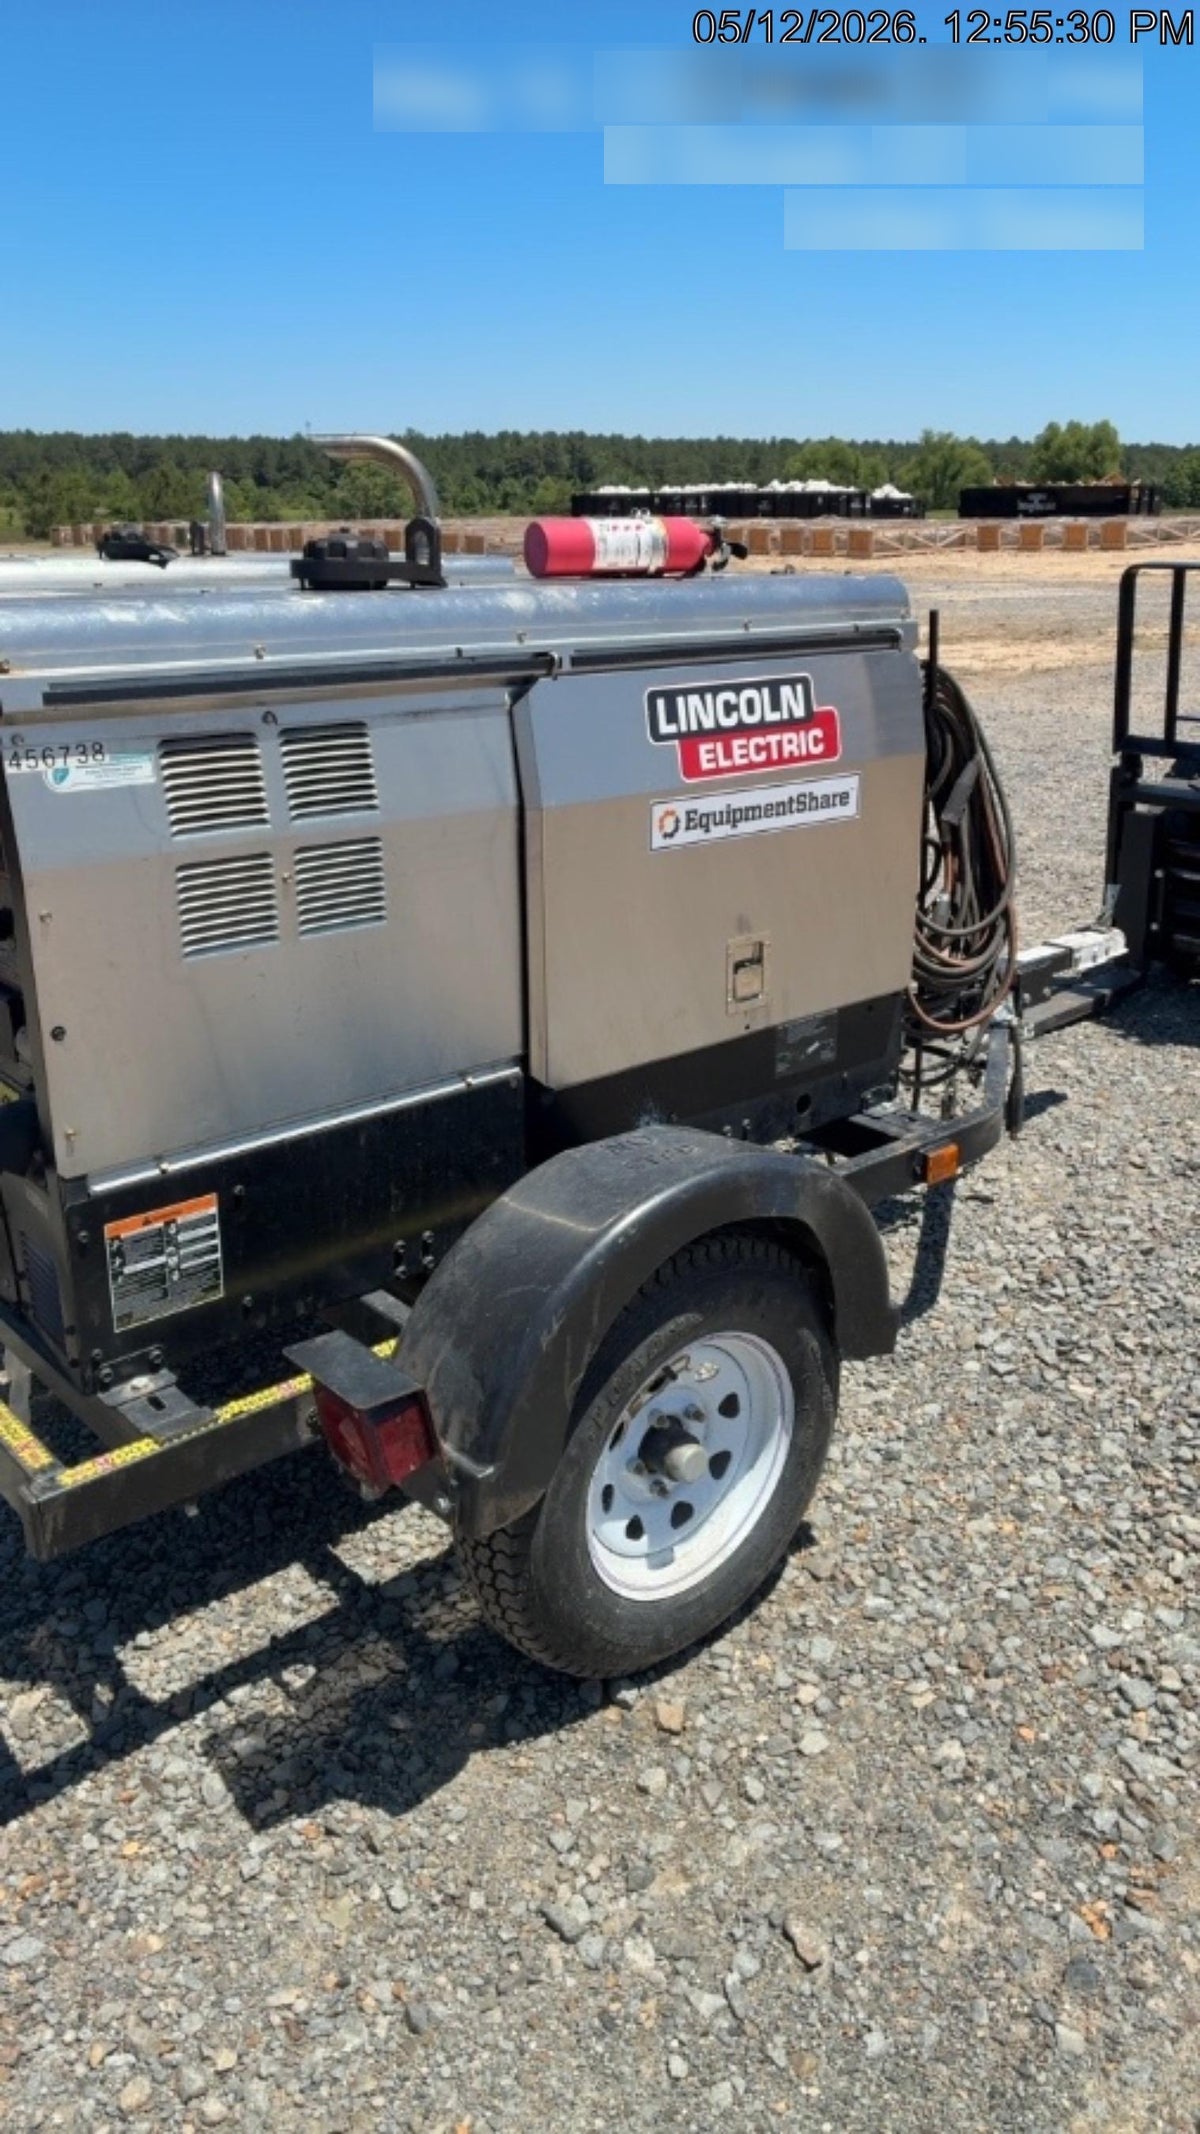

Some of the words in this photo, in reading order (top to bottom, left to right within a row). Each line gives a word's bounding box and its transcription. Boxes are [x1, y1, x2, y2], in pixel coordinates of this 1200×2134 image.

[656, 683, 806, 735] LINCOLN
[9, 742, 105, 769] 456738
[698, 727, 825, 772] ELECTRIC
[685, 790, 850, 834] EquipmentShare
